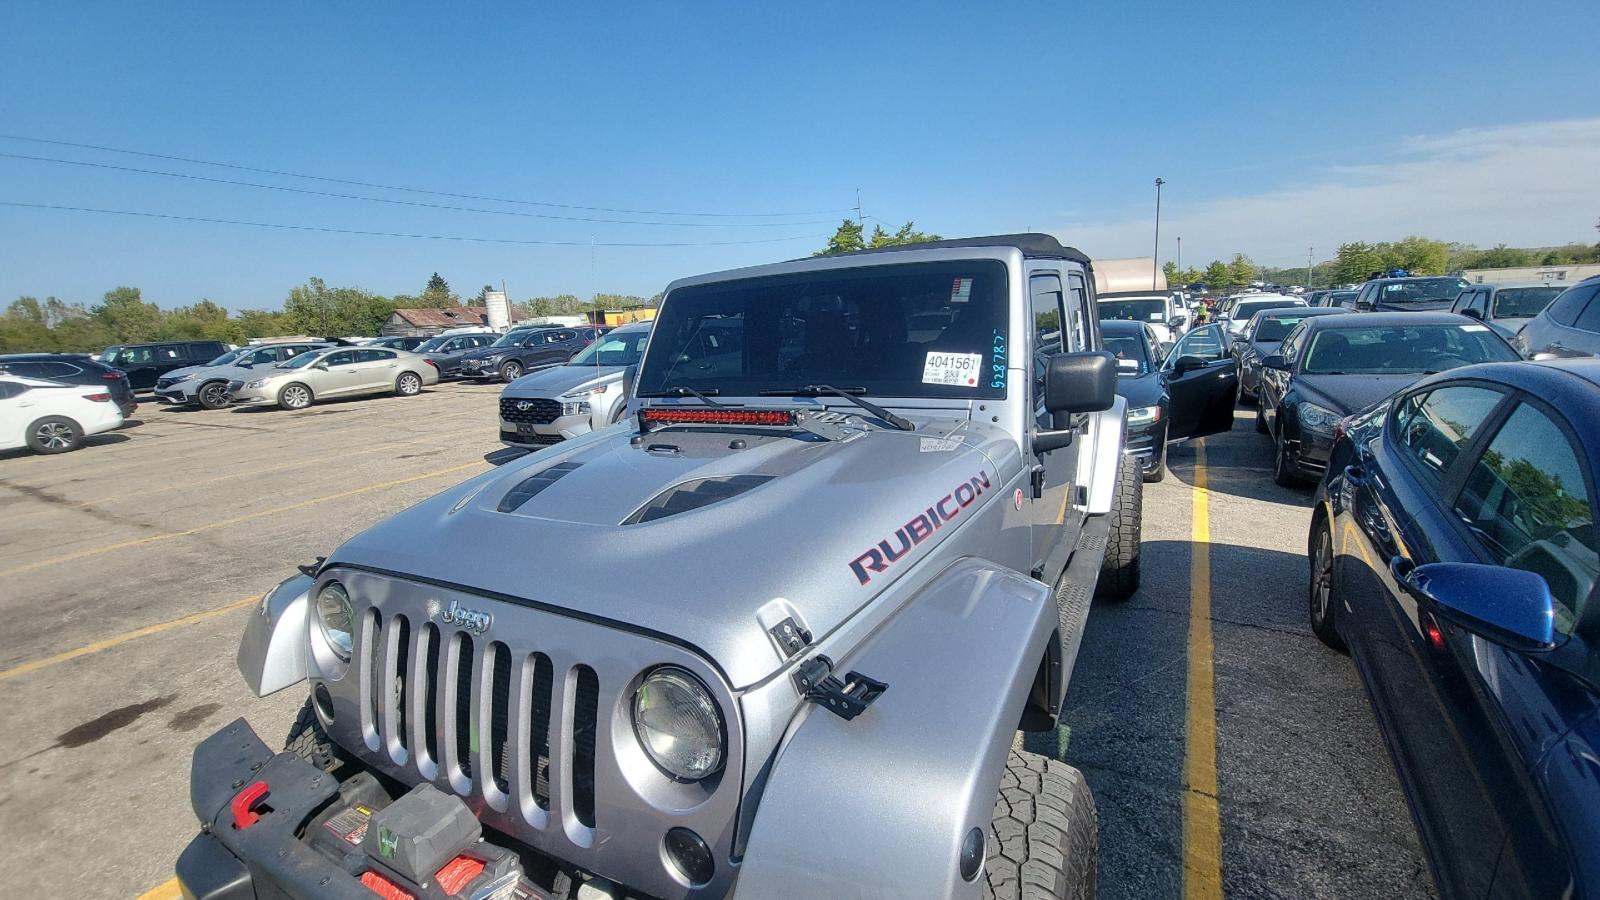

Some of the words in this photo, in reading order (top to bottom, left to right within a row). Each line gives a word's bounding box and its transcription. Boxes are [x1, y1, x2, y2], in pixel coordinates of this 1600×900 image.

[928, 355, 976, 370] 4041561
[849, 471, 991, 586] RUBICON
[442, 601, 490, 636] Jeep
